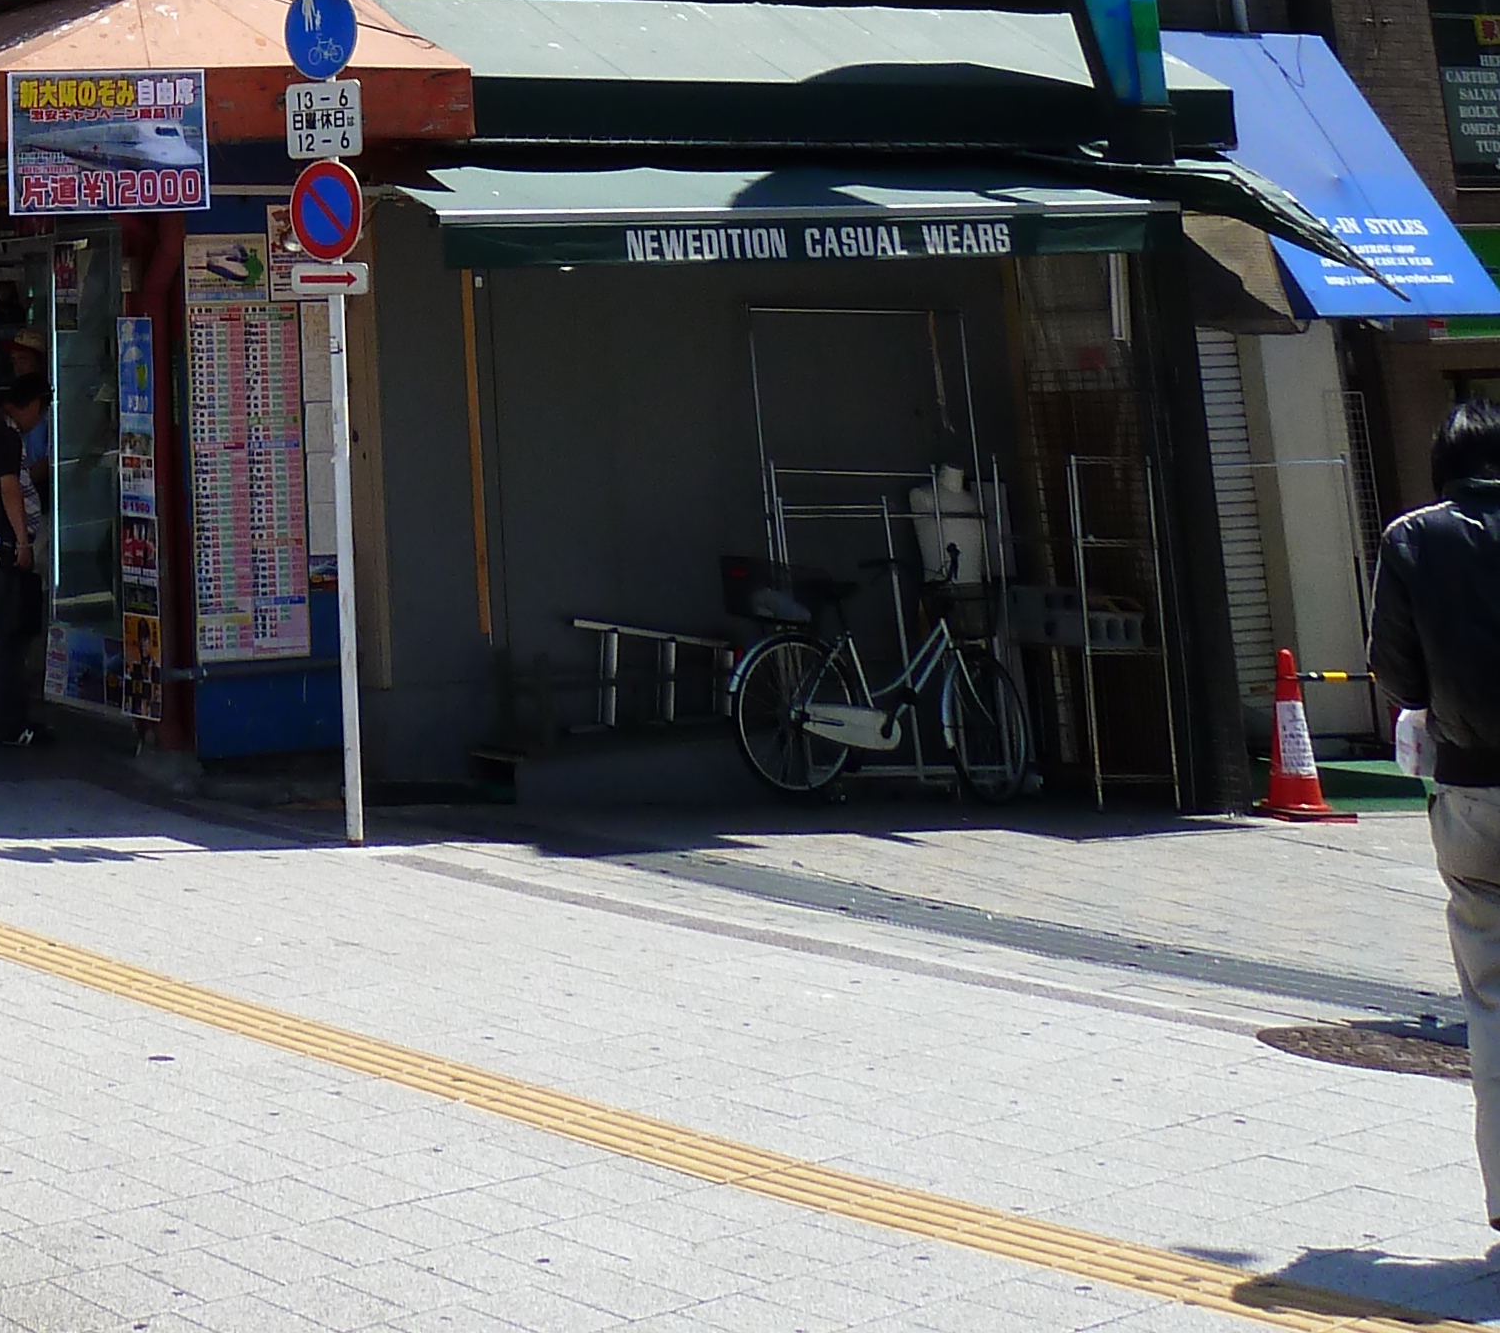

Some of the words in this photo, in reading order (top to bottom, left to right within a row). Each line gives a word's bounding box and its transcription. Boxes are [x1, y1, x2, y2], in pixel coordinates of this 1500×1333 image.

[1446, 70, 1499, 84] CARTIER
[1459, 105, 1499, 118] ROLEX
[1364, 217, 1429, 236] STYLES
[626, 228, 788, 263] NEWEDITION
[805, 226, 908, 259] CASUAL
[921, 222, 1012, 256] WEARS
[1350, 244, 1393, 255] LOTHING
